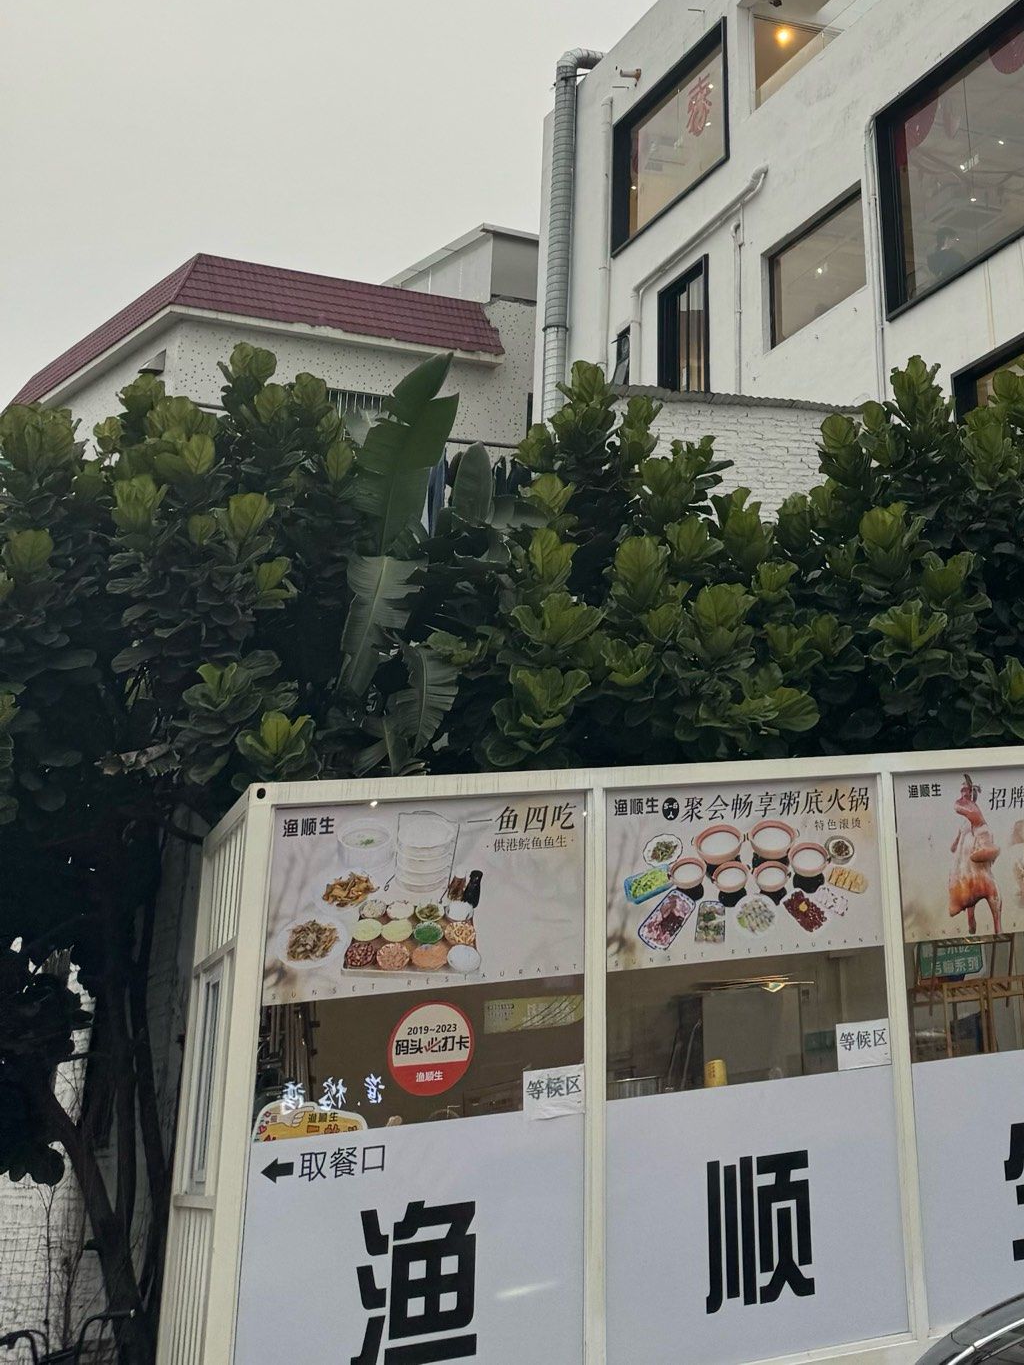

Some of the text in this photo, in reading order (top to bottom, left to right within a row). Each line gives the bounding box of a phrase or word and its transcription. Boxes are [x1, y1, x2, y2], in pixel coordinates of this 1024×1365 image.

[908, 784, 942, 799] 渔顺生
[614, 798, 659, 816] 渔顺生
[680, 787, 870, 823] 聚会畅享粥底火锅
[282, 817, 335, 837] 渔顺生
[467, 802, 578, 835] 一鱼四吃
[407, 1023, 457, 1035] 2019~2023
[839, 1028, 887, 1051] 等候区
[395, 1035, 469, 1055] 码头必打卡
[526, 1074, 581, 1100] 等候区
[299, 1145, 385, 1181] 取餐口
[350, 1200, 477, 1365] 渔
[706, 1150, 815, 1313] 顺
